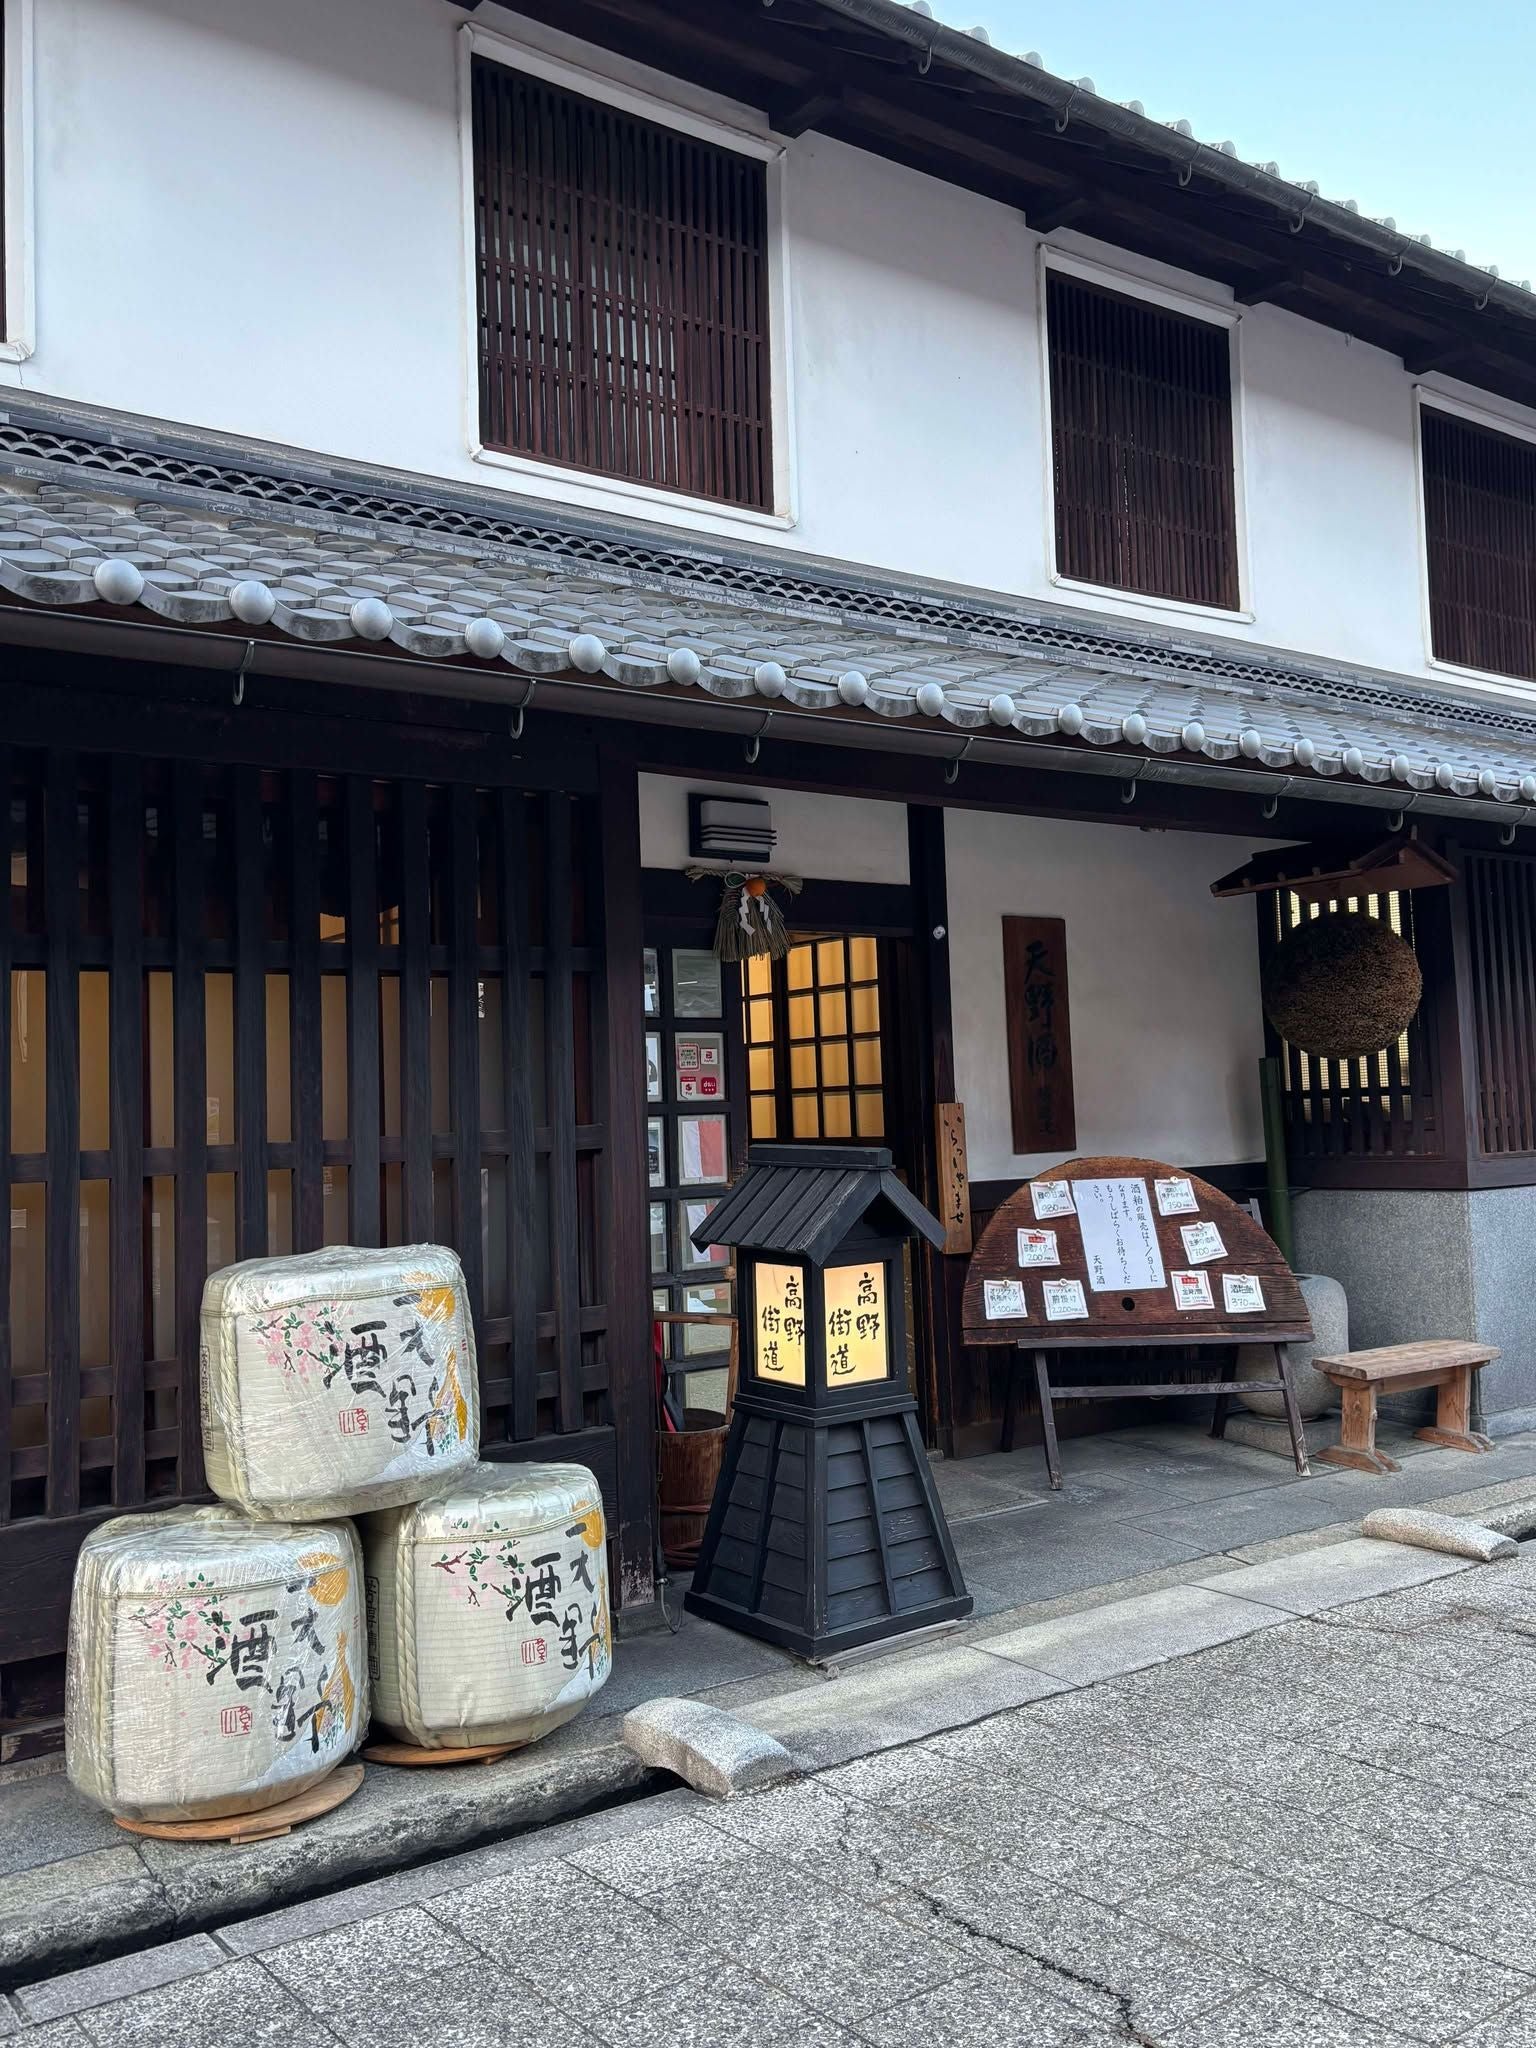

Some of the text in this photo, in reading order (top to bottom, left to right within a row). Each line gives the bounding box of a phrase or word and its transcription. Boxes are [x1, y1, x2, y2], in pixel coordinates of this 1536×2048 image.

[944, 1116, 965, 1226] いらっしゃいませ
[1092, 1184, 1104, 1203] さい。
[1118, 1184, 1133, 1222] なります。
[1106, 1184, 1131, 1284] もうしばらくお待ちくだ
[1092, 1255, 1106, 1285] 天野酒
[762, 1305, 784, 1371] 街道
[784, 1275, 805, 1345] 高野
[856, 1272, 881, 1340] 高野
[828, 1308, 857, 1375] 街道
